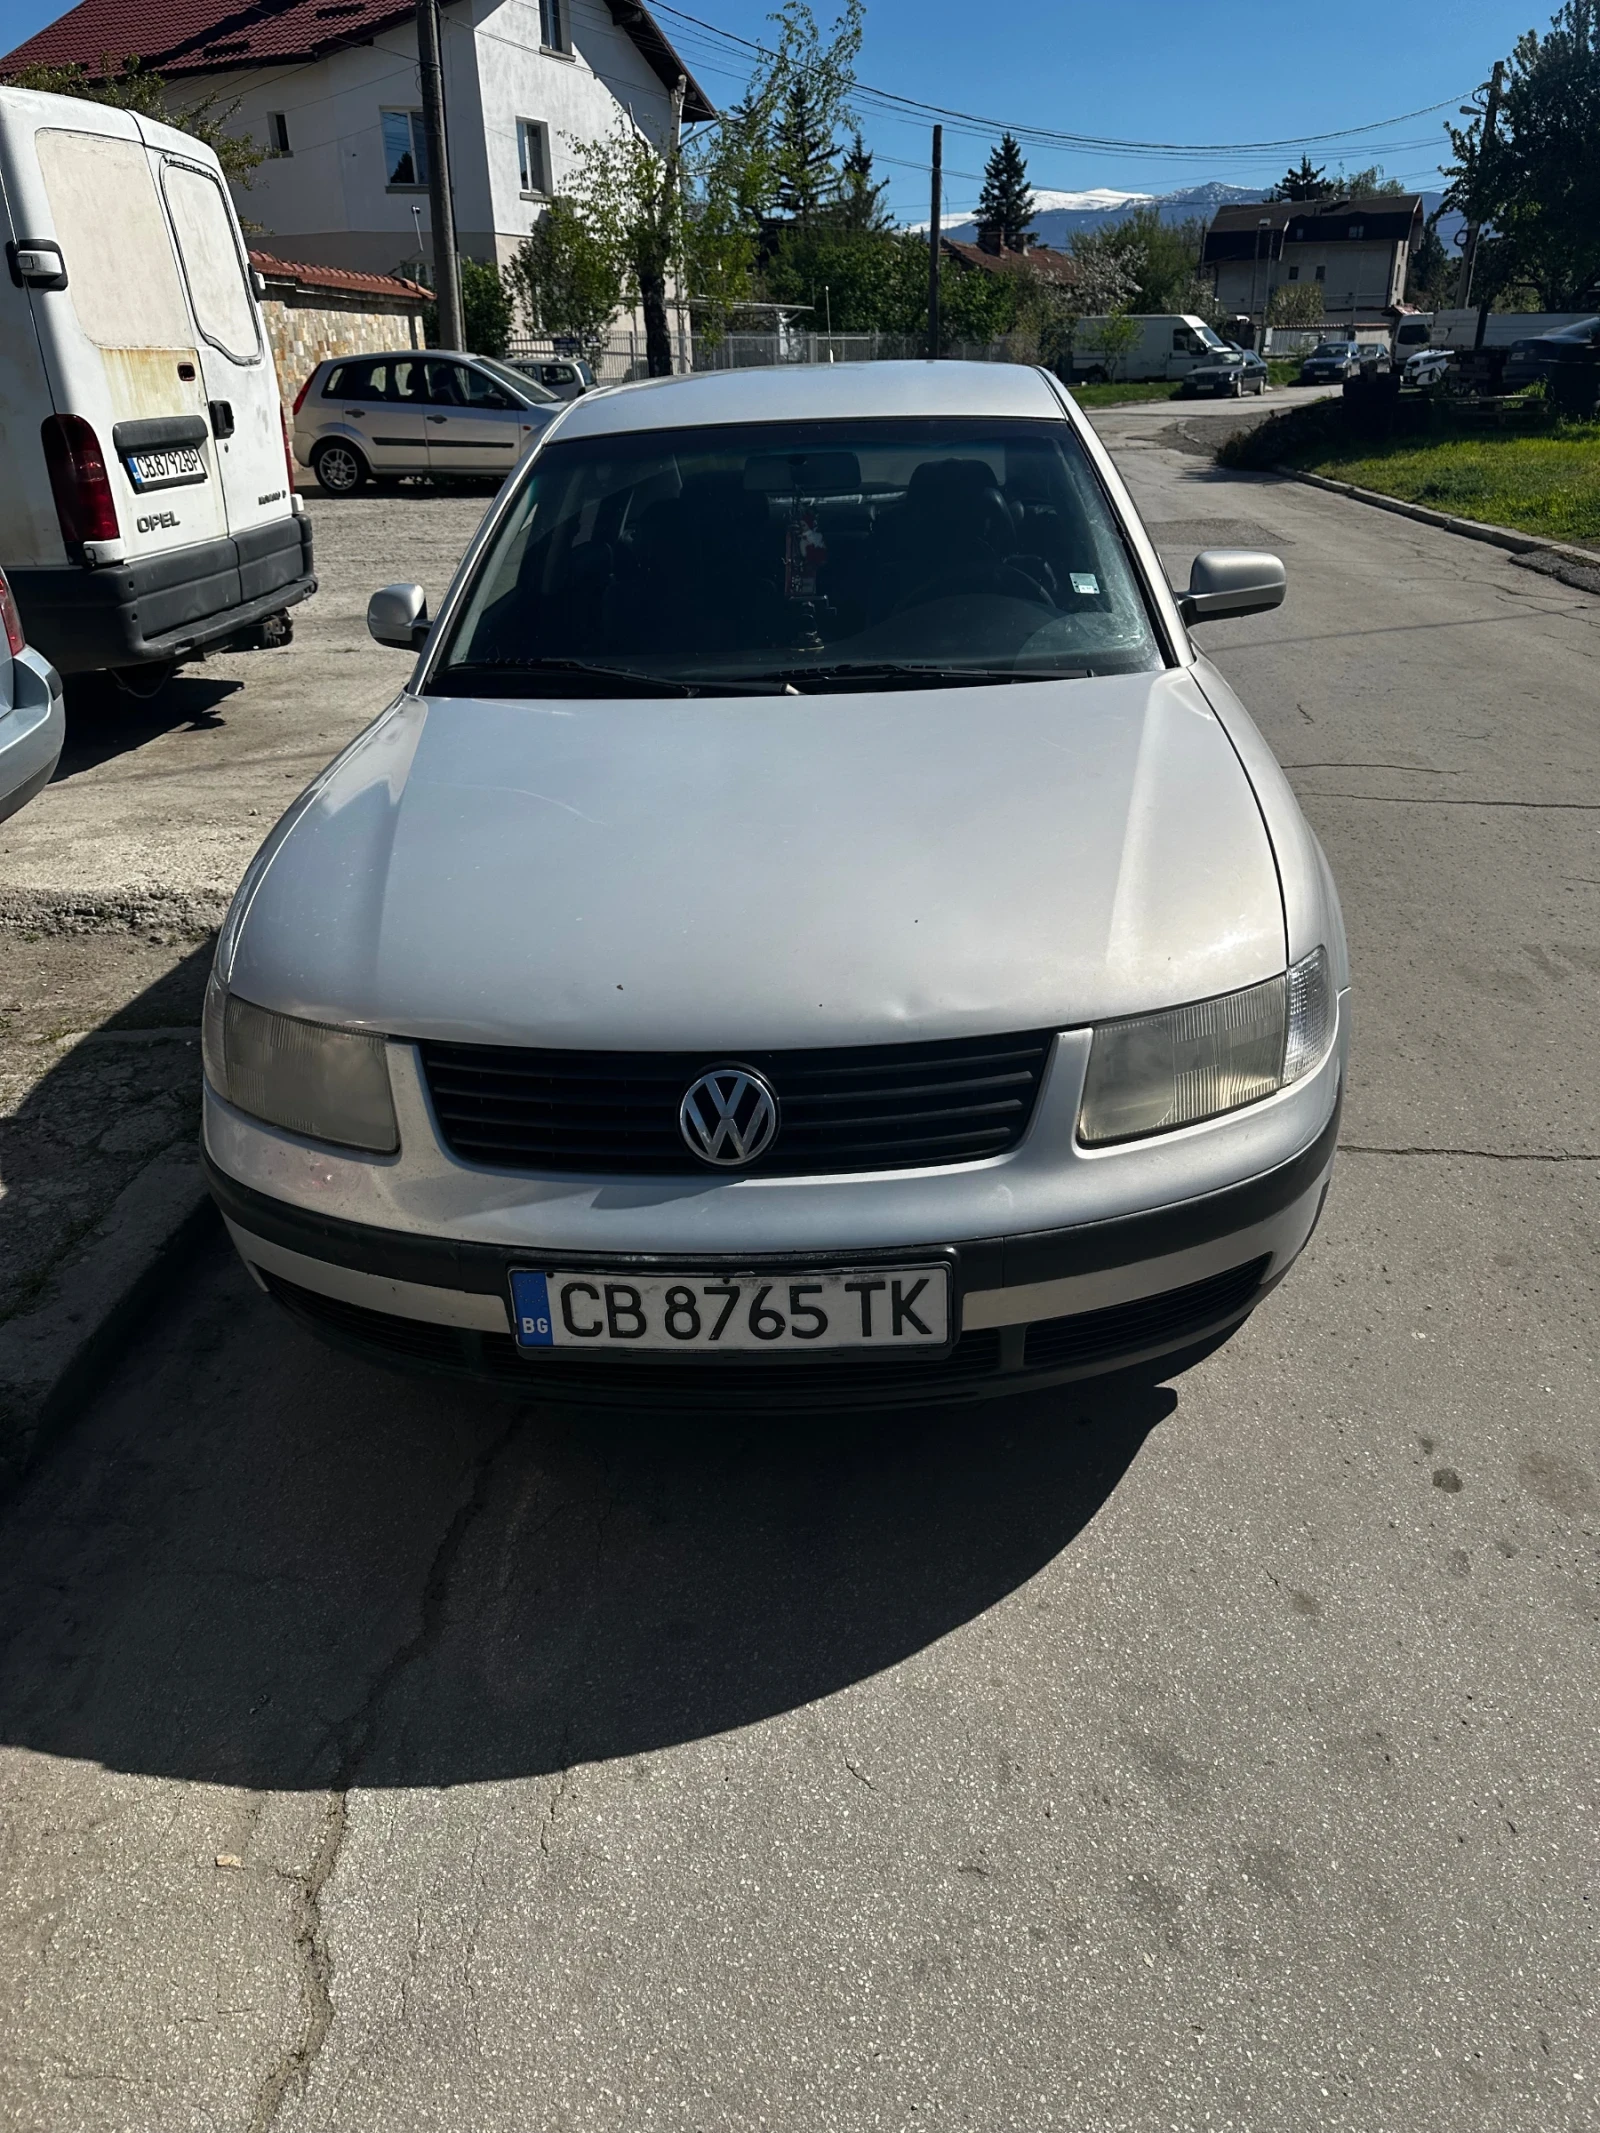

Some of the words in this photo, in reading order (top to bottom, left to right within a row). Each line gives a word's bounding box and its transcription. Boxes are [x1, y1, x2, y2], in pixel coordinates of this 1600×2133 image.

[137, 511, 181, 533] OPEL
[681, 1070, 776, 1165] VW
[522, 1317, 549, 1334] BG
[560, 1282, 647, 1338] CB
[664, 1285, 828, 1340] 8765
[845, 1279, 933, 1337] TK
